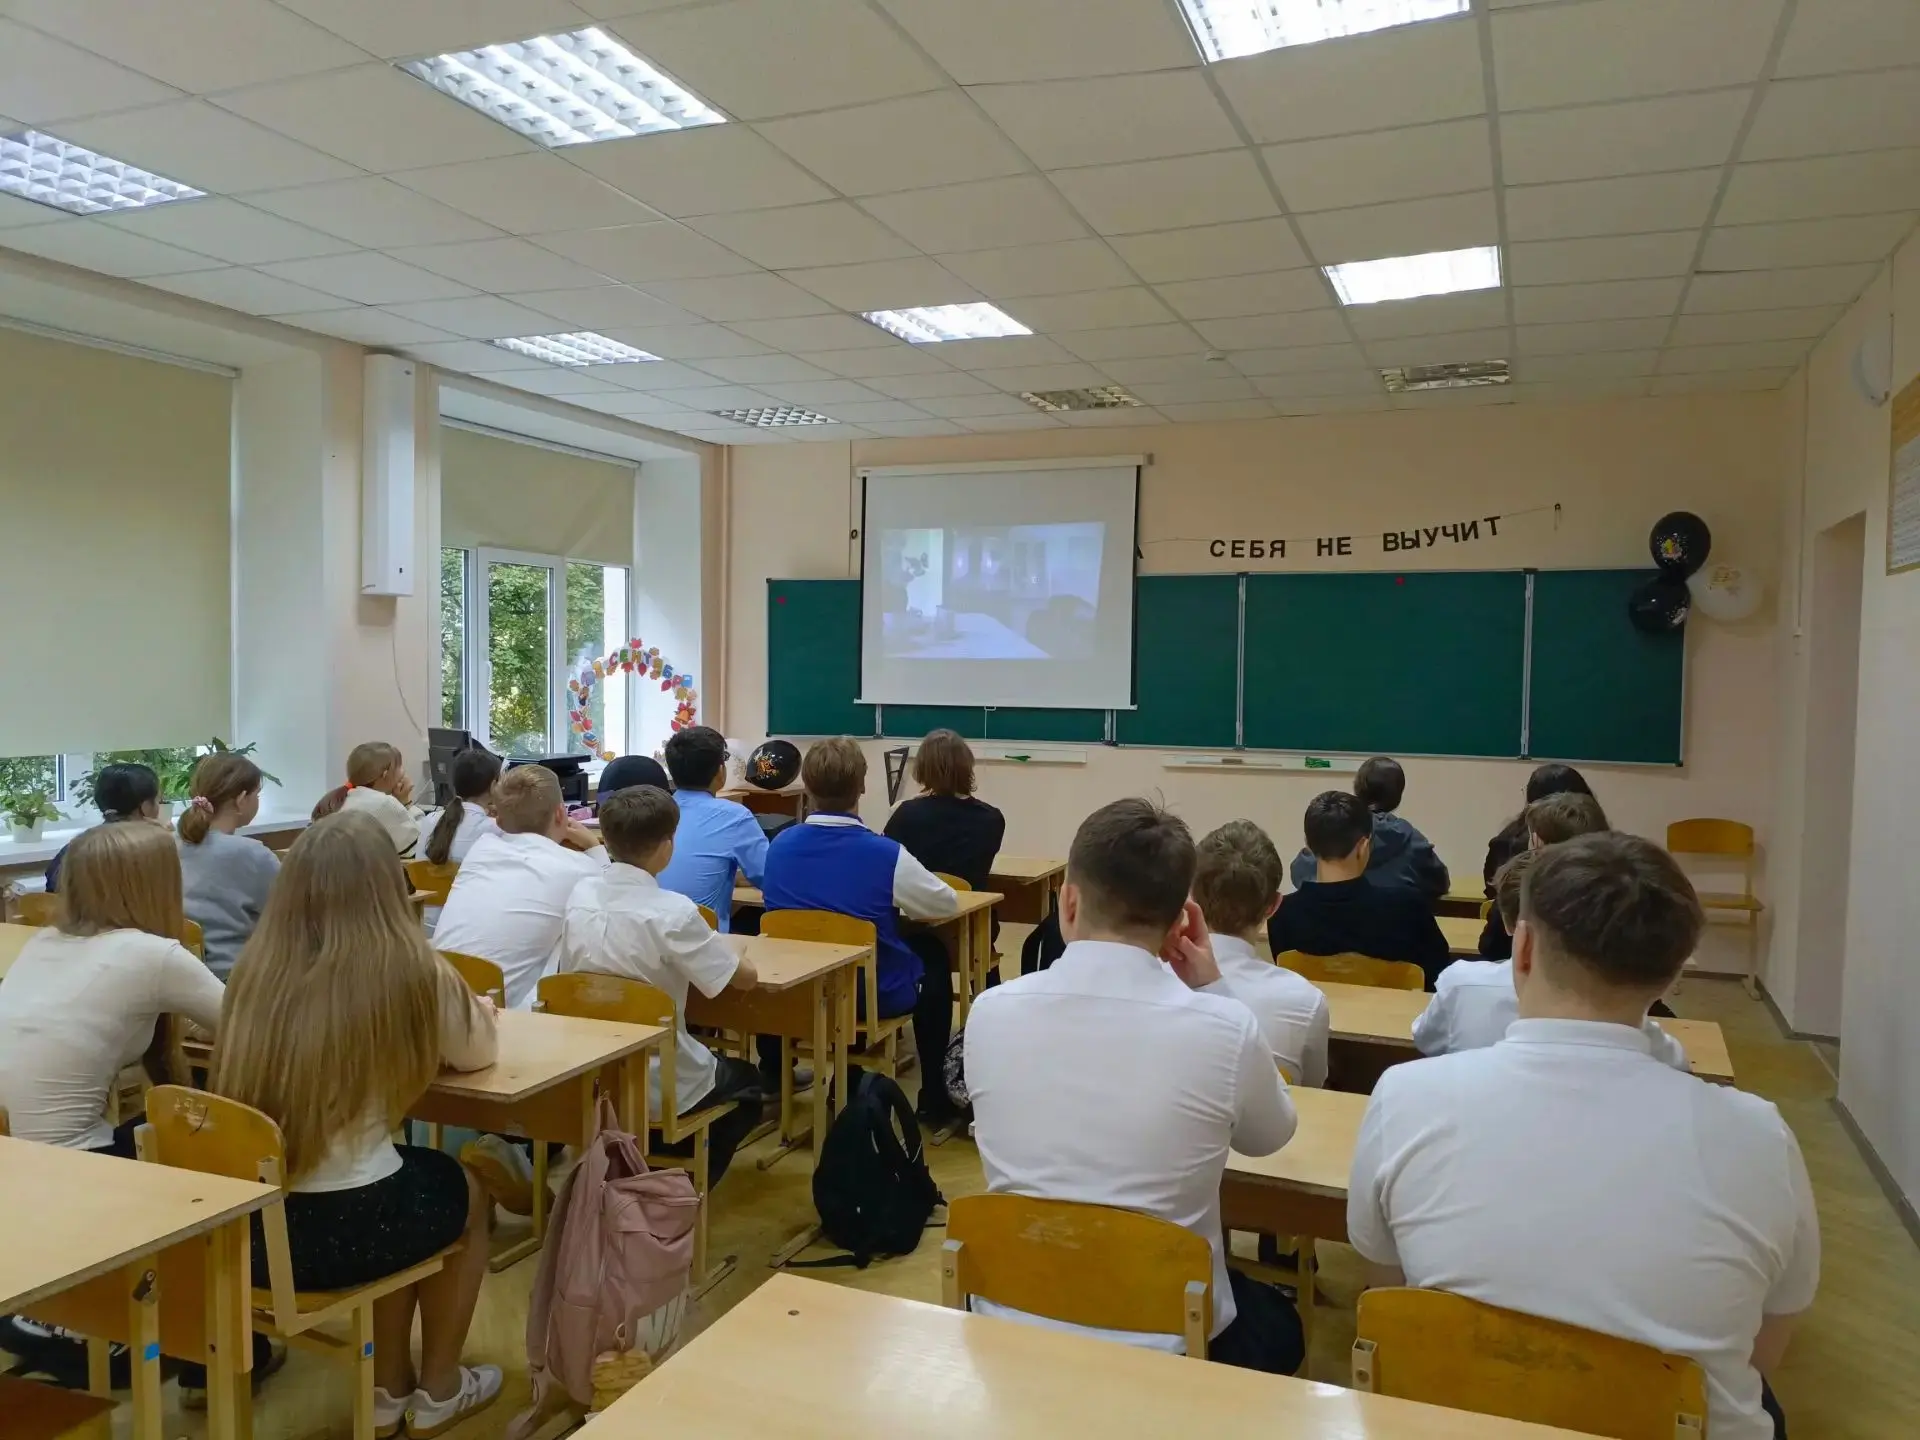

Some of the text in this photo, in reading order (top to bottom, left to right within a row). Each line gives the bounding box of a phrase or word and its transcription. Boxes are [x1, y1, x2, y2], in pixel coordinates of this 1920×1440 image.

[1210, 516, 1501, 558] СЕБЯ НЕ ВЫУЧИТ
